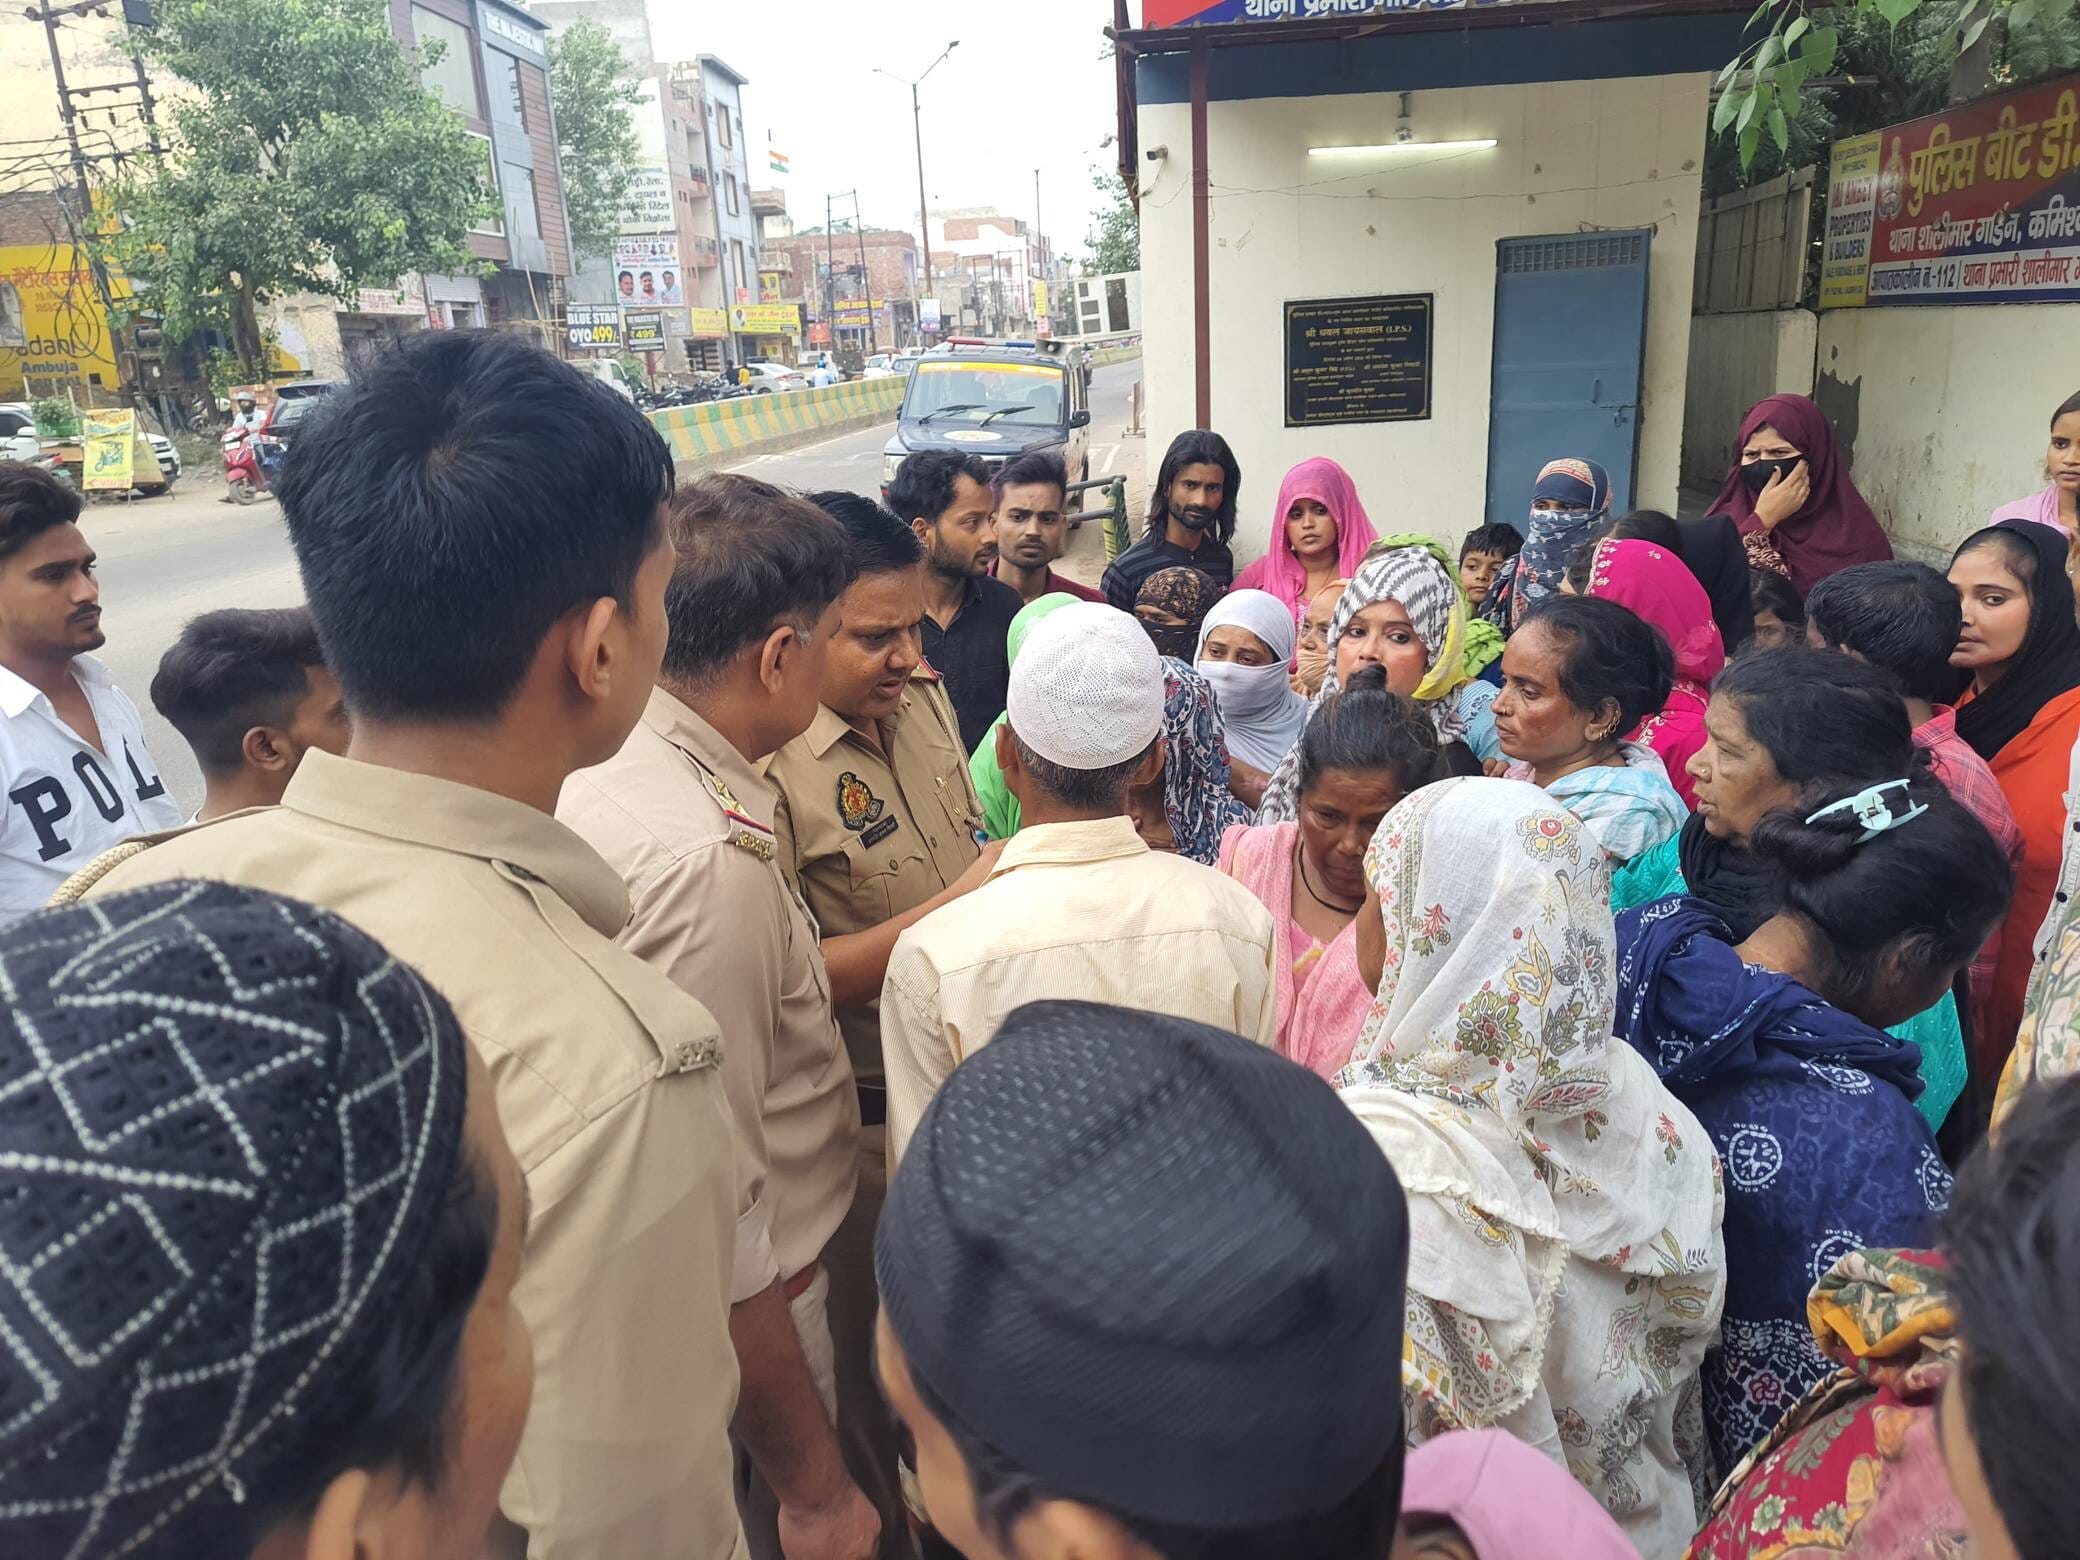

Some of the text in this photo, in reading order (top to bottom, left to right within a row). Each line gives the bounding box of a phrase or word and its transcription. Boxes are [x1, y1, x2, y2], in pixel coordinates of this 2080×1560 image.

[1907, 122, 1982, 218] पुलिस
[1983, 105, 2038, 181] बीट
[1889, 227, 1916, 253] थाना
[1917, 211, 1974, 251] शालीमार
[1963, 262, 1988, 287] थाना
[1988, 252, 2020, 289] प्रभारी
[2022, 249, 2073, 286] शालीमार
[567, 313, 592, 325] BLUE
[593, 312, 618, 324] STAR
[570, 328, 592, 343] OYO
[22, 360, 79, 374] Ambuja
